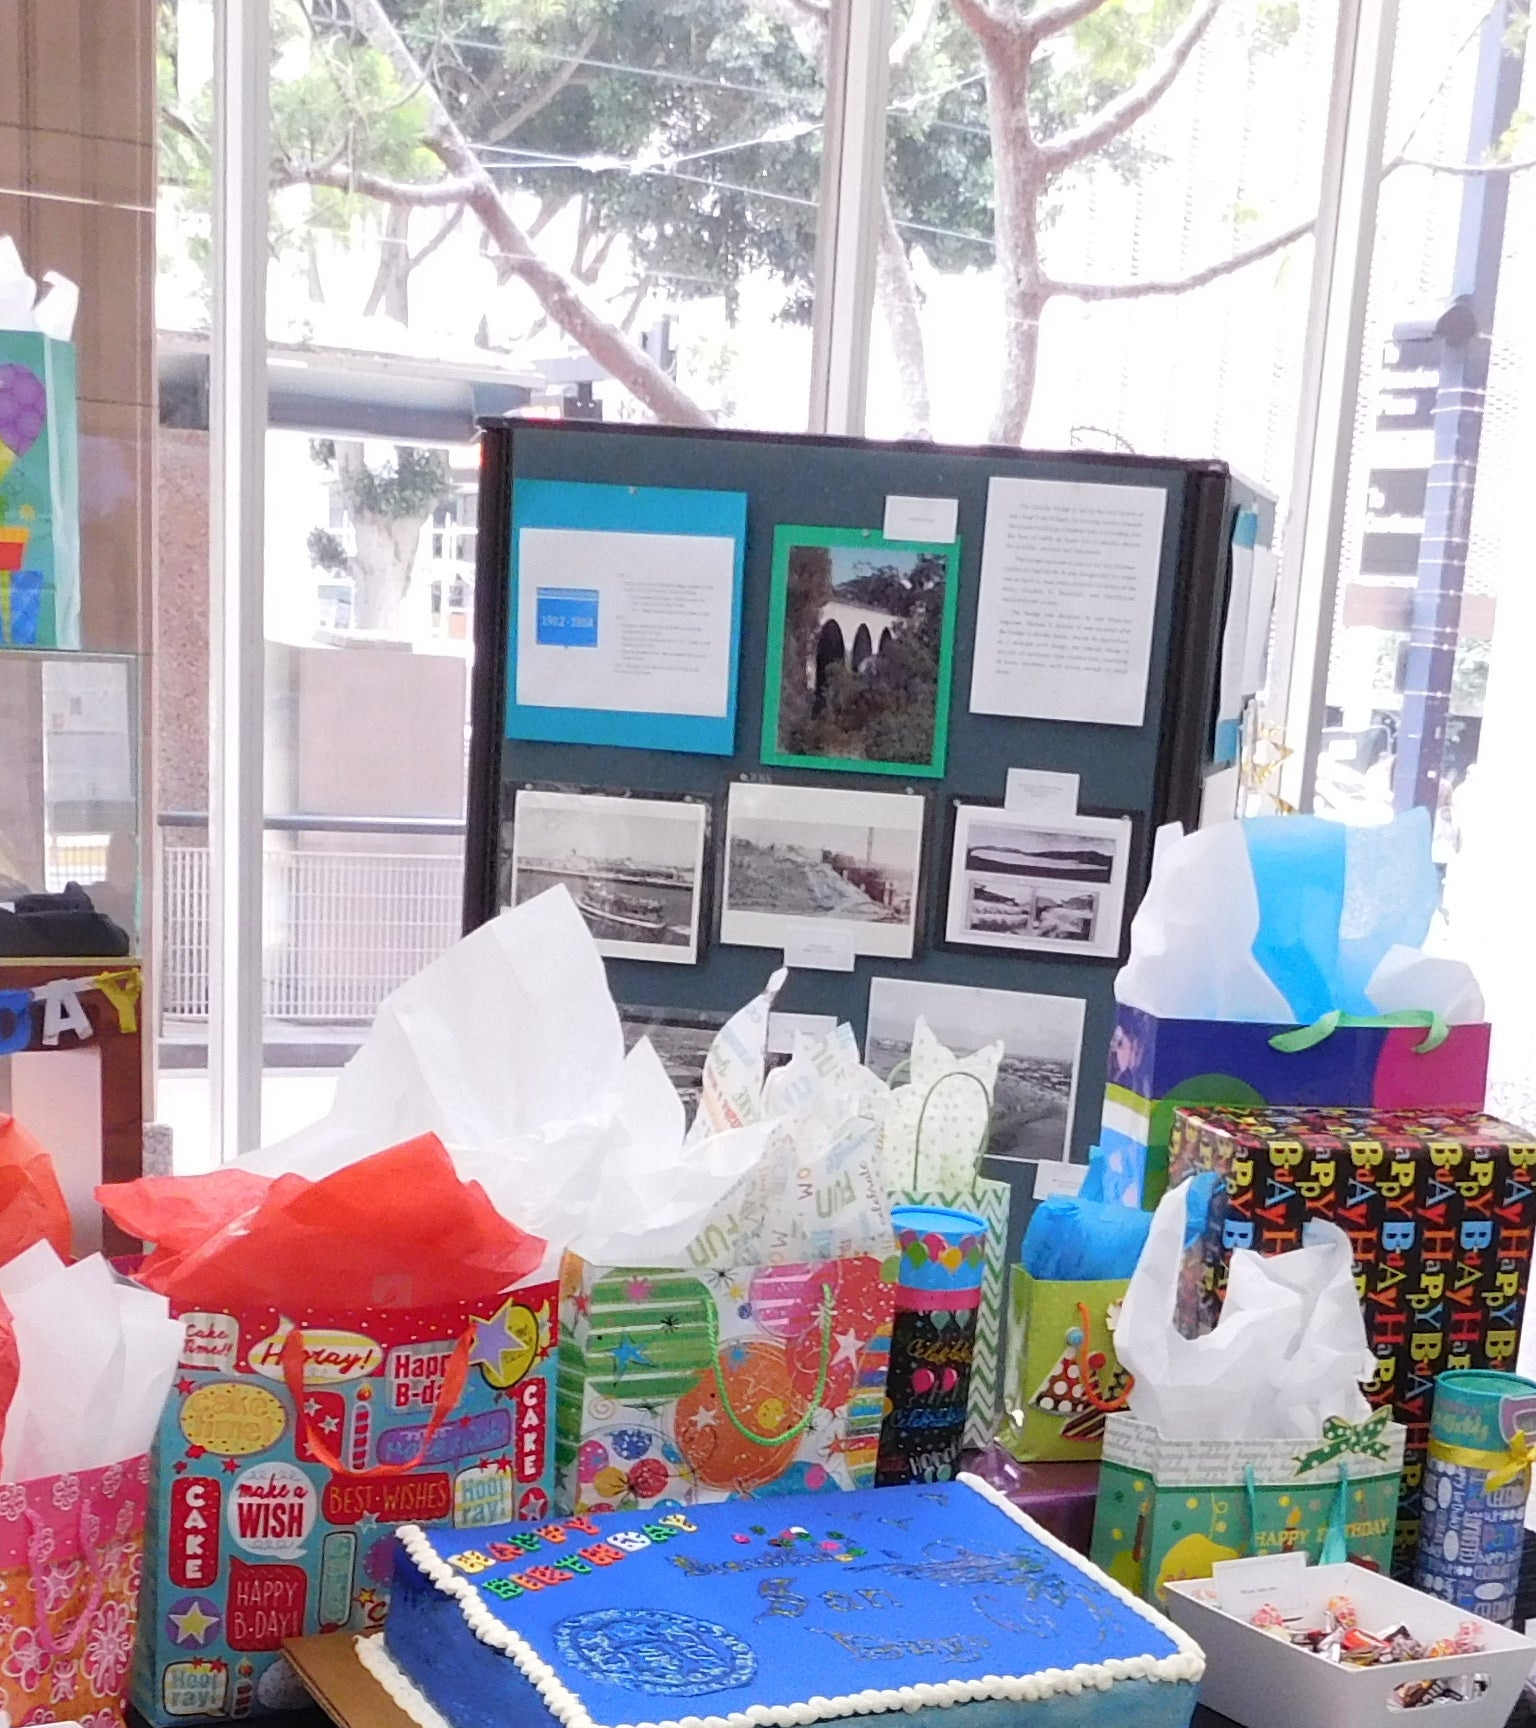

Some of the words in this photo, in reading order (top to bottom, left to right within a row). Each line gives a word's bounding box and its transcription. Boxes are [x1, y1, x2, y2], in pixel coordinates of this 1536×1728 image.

[260, 1341, 375, 1375] Hray!
[395, 1352, 454, 1379] Hap
[521, 1384, 540, 1476] CAKE
[184, 1484, 208, 1580] CAKE
[237, 1502, 303, 1539] WISH
[1255, 1529, 1311, 1547] HAPPY
[1316, 1518, 1390, 1543] BTHDAY
[236, 1580, 300, 1607] HAPPY
